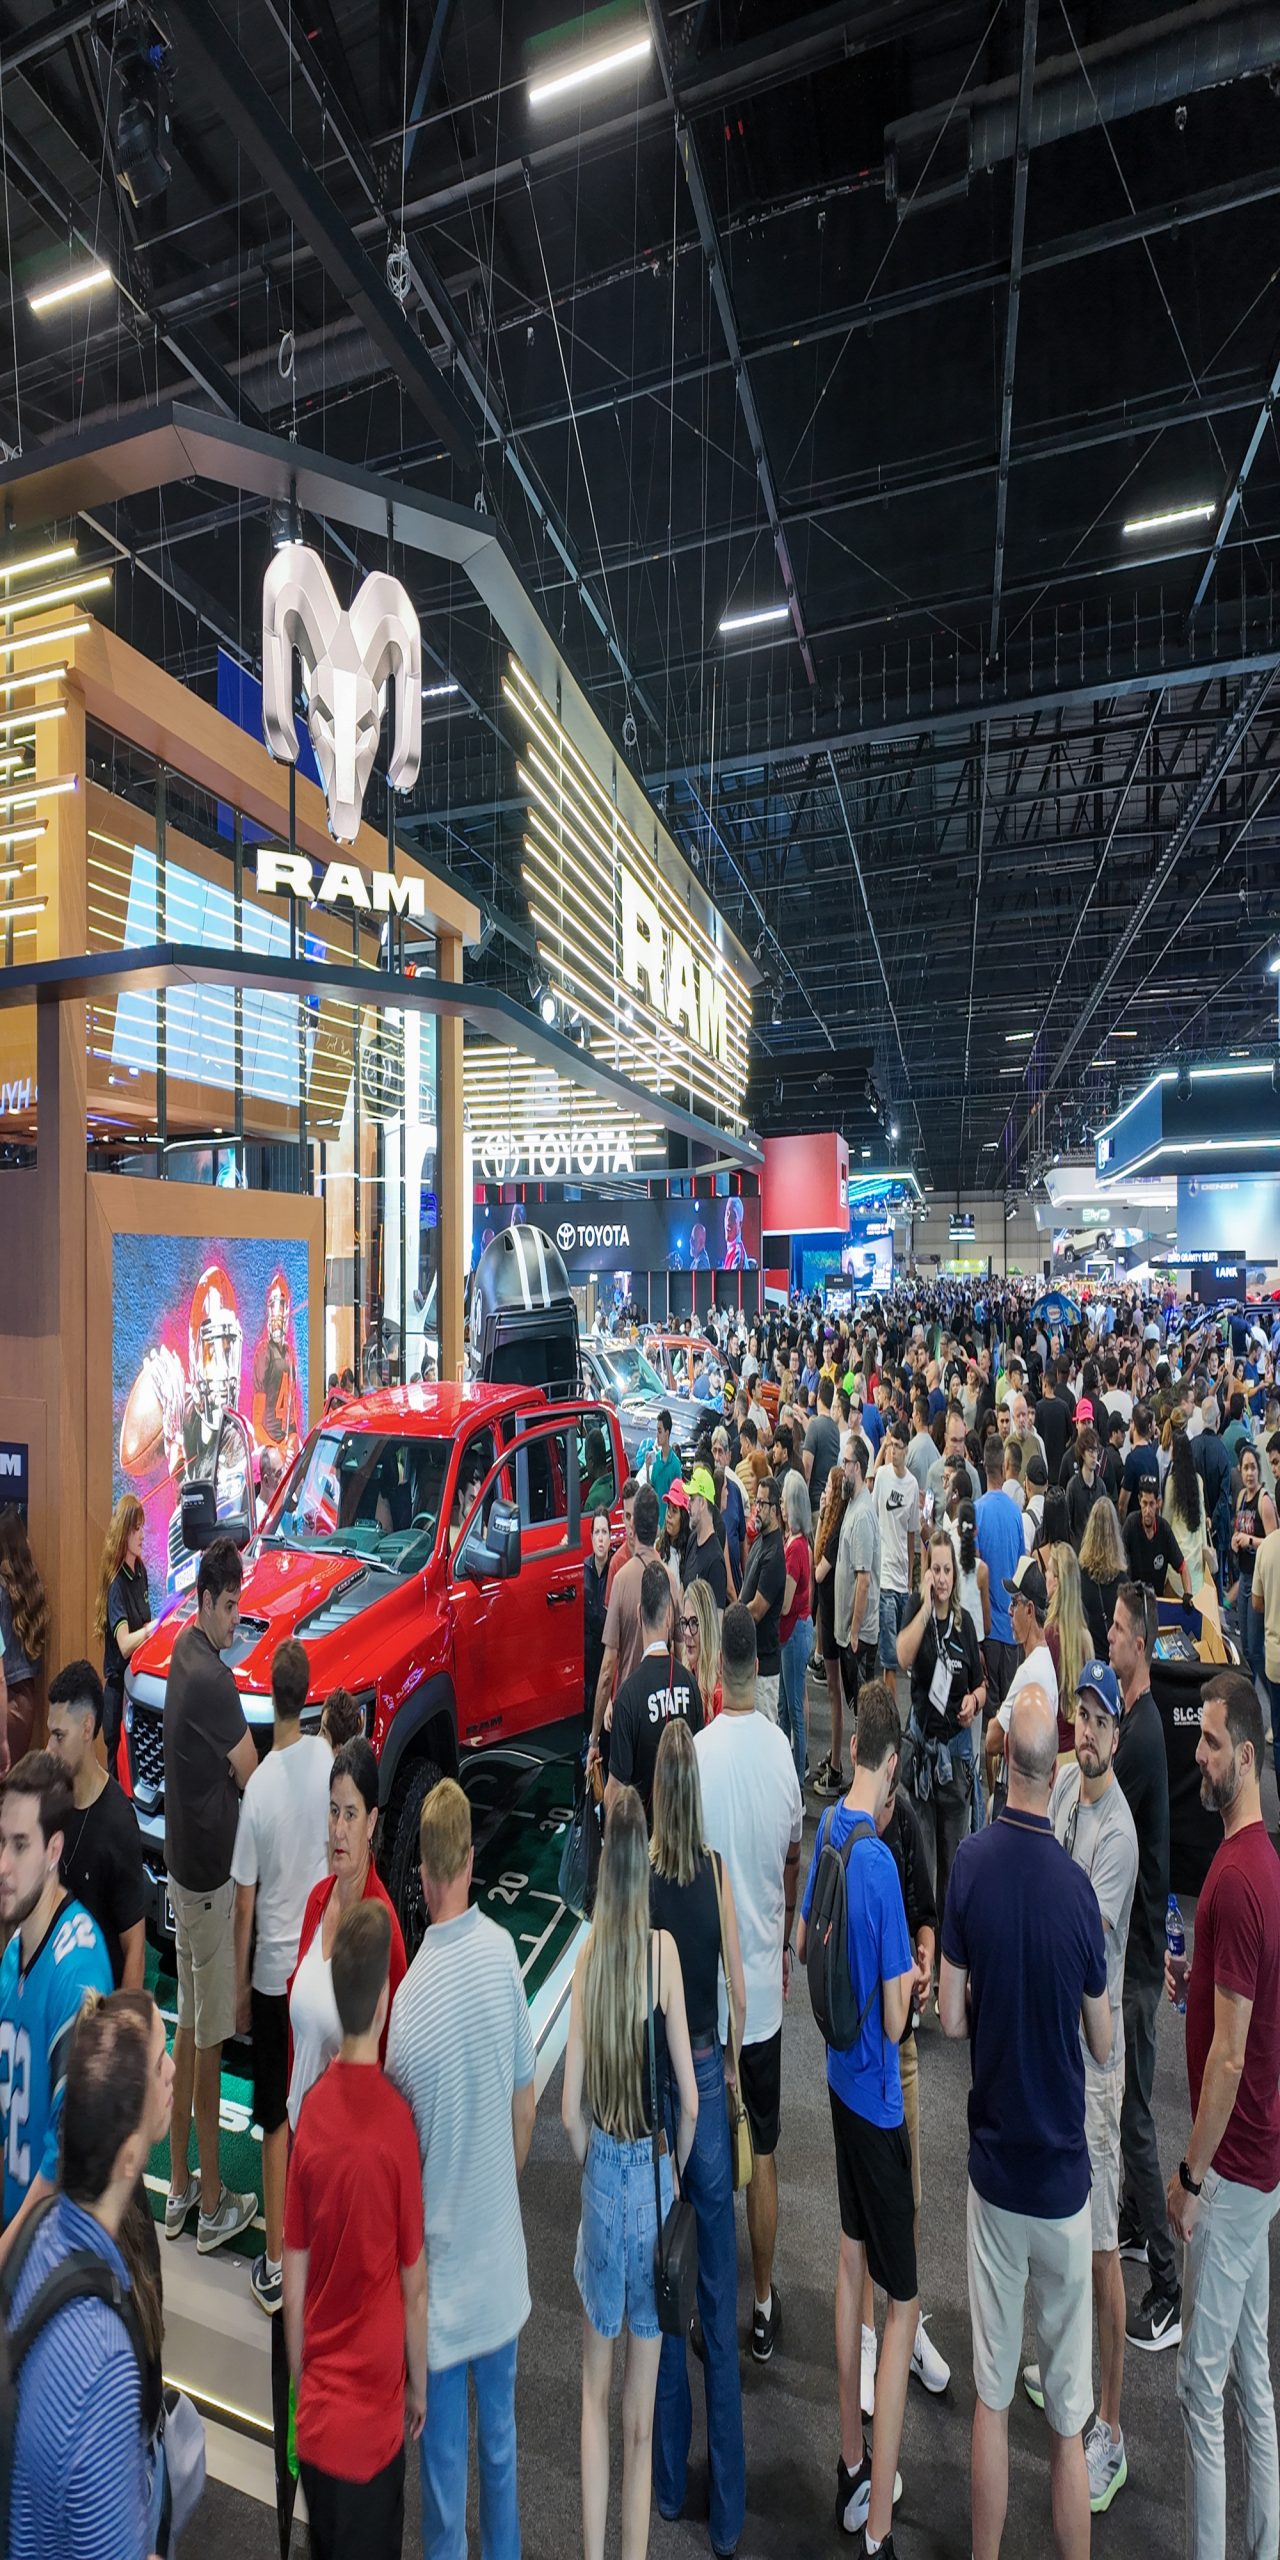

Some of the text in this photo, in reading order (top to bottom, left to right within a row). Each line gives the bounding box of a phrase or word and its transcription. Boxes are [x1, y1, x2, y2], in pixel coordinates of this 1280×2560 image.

[257, 849, 425, 917] RAM
[621, 862, 727, 1062] RAM
[524, 1131, 634, 1176] TOYOTA
[577, 1225, 630, 1247] TOYOTA
[275, 1371, 296, 1431] 4
[890, 1489, 904, 1503] NIKE
[647, 1686, 690, 1723] STAFF
[539, 1807, 575, 1834] 30
[487, 1871, 529, 1905] 20
[52, 1912, 97, 1966] 22
[0, 2020, 32, 2187] 22
